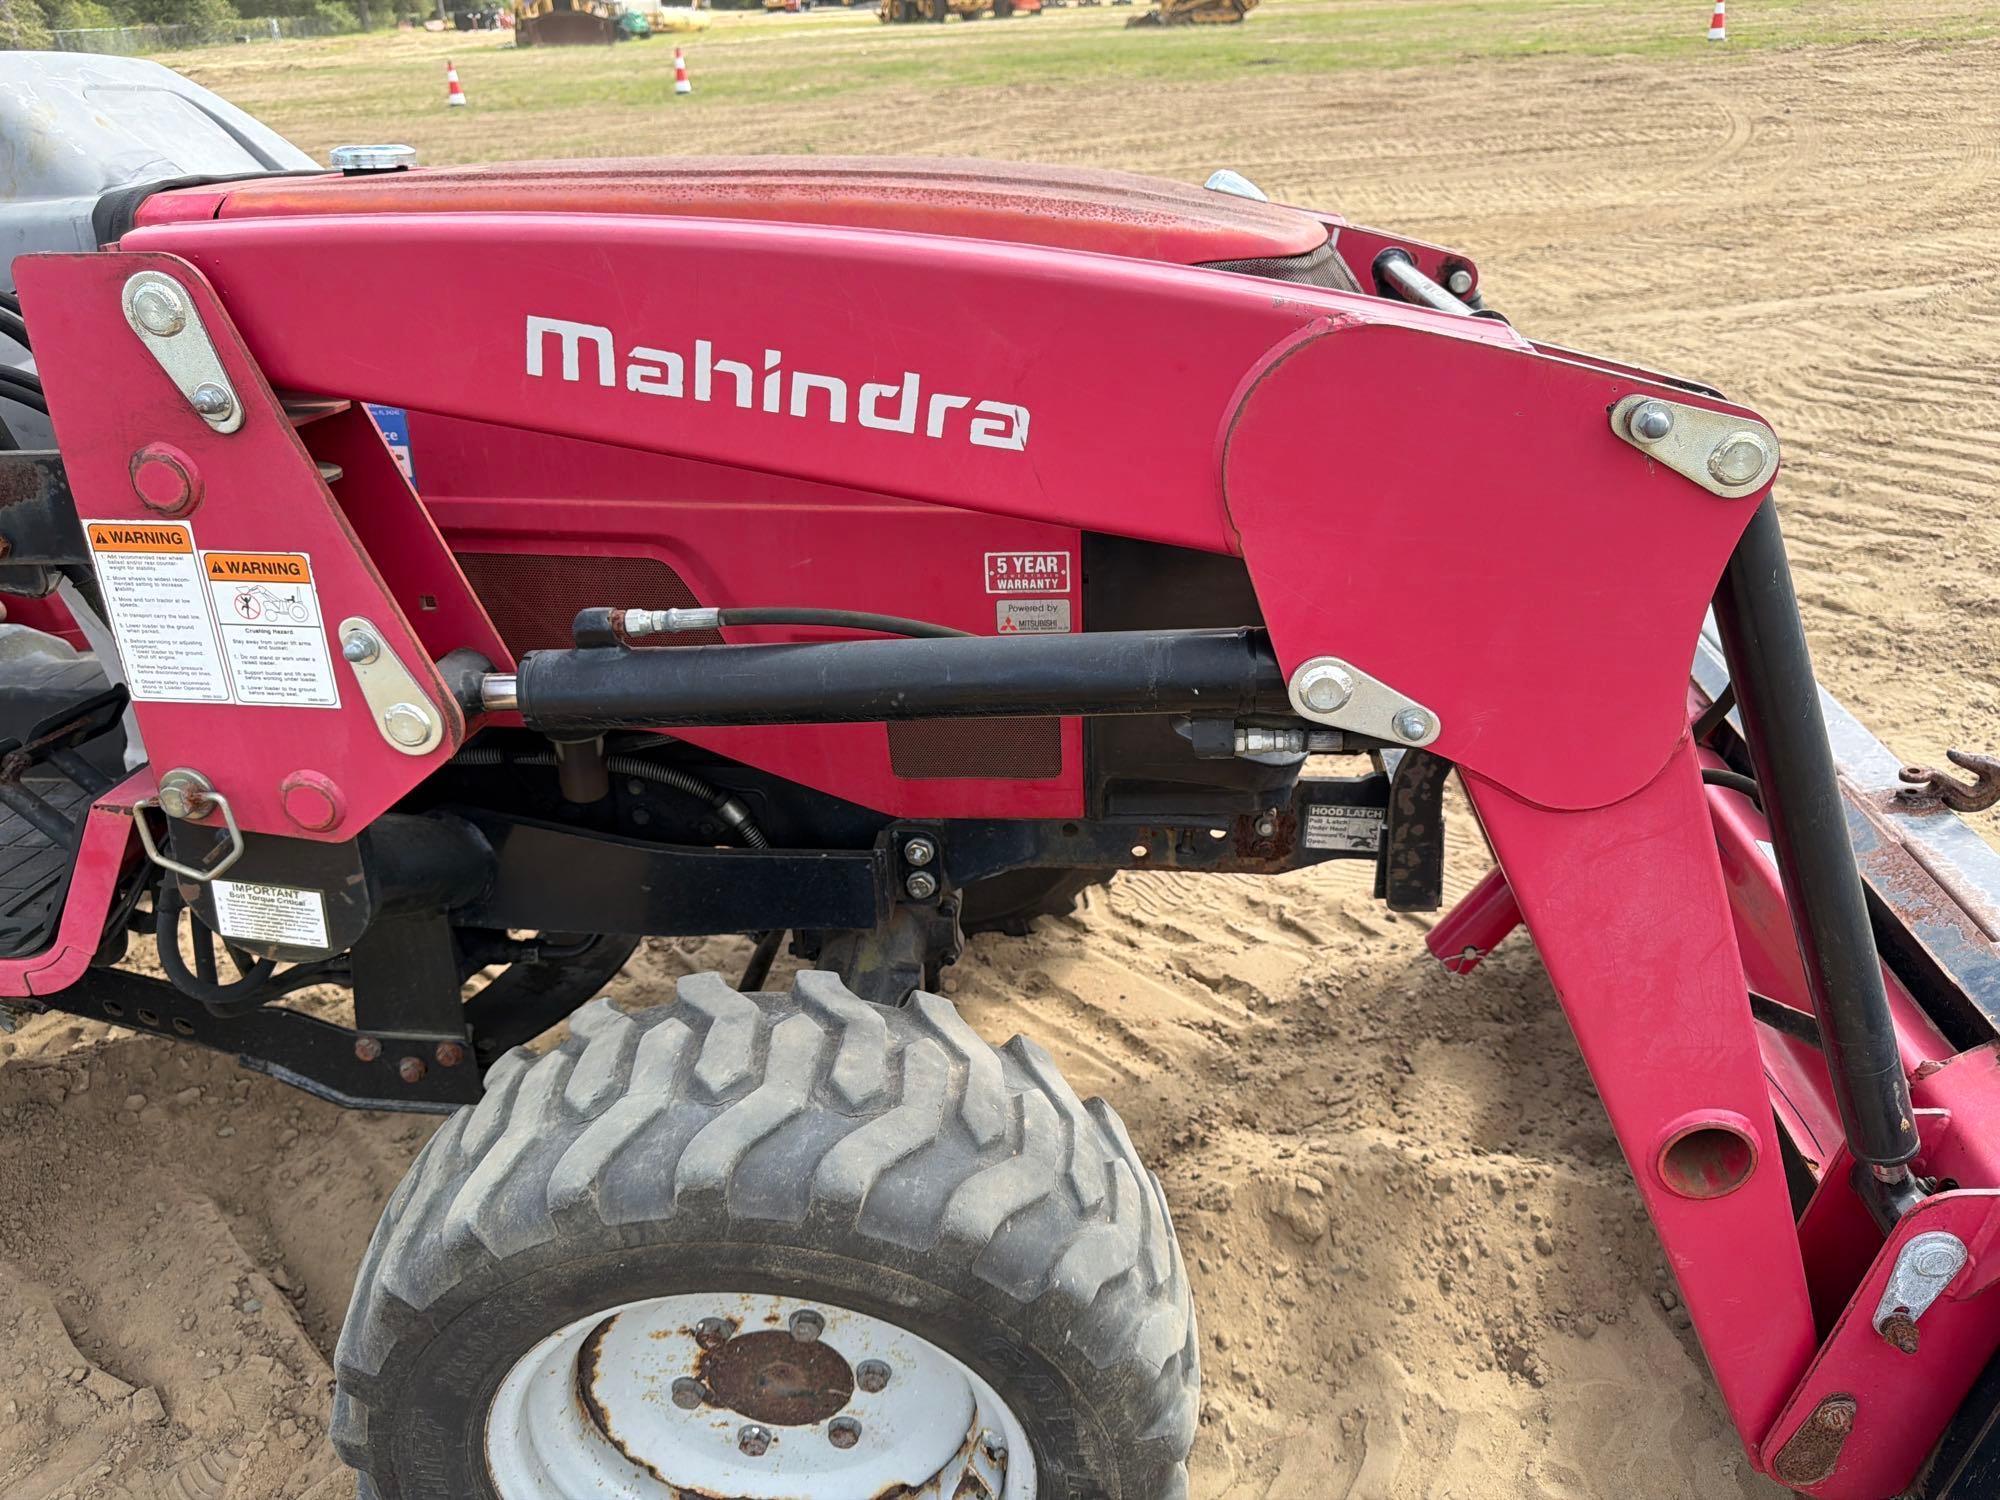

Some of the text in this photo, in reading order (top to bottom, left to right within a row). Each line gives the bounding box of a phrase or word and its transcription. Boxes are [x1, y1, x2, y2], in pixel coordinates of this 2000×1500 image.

[110, 531, 184, 545] WARNING
[226, 561, 300, 575] WARNING
[997, 556, 1058, 574] 5 YEAR
[997, 579, 1058, 589] WARRANTY
[1008, 604, 1058, 613] Powered by
[1312, 807, 1382, 818] HOOD LATCH
[232, 884, 300, 899] IMPORTANT
[229, 892, 306, 906] Bolt Torque Critical
